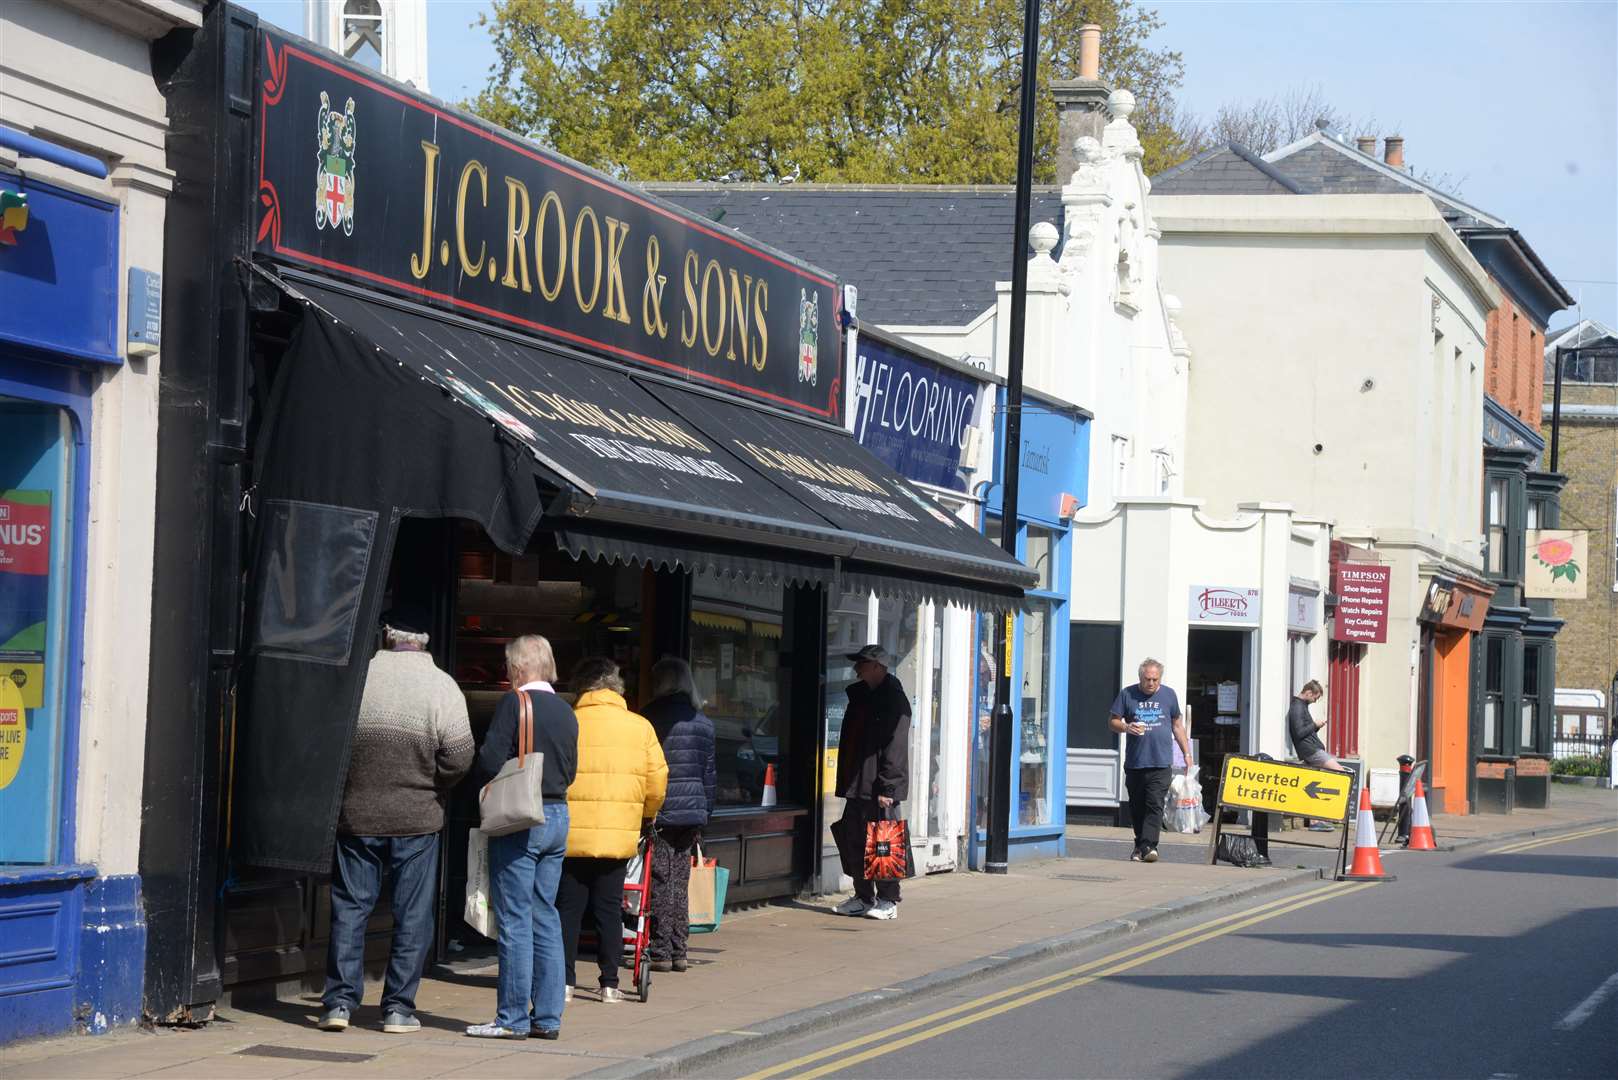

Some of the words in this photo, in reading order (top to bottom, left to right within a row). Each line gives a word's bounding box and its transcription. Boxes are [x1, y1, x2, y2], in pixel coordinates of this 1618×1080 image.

[642, 234, 668, 339] &
[681, 249, 768, 372] SONS
[1341, 570, 1386, 581] TIMPSON
[1344, 585, 1359, 593] Shoe
[1360, 586, 1382, 595] Repairs
[1342, 596, 1360, 604] Phone
[1362, 597, 1383, 606] Repairs
[1341, 606, 1360, 614] Watch
[1361, 608, 1383, 616] Repairs
[1345, 617, 1355, 626] Key
[1356, 618, 1378, 628] Cutting
[1346, 628, 1376, 639] Engraving
[1138, 701, 1160, 709] SITE
[6, 730, 21, 744] LIVE
[1231, 766, 1300, 788] Diverted
[1237, 784, 1287, 804] traffic
